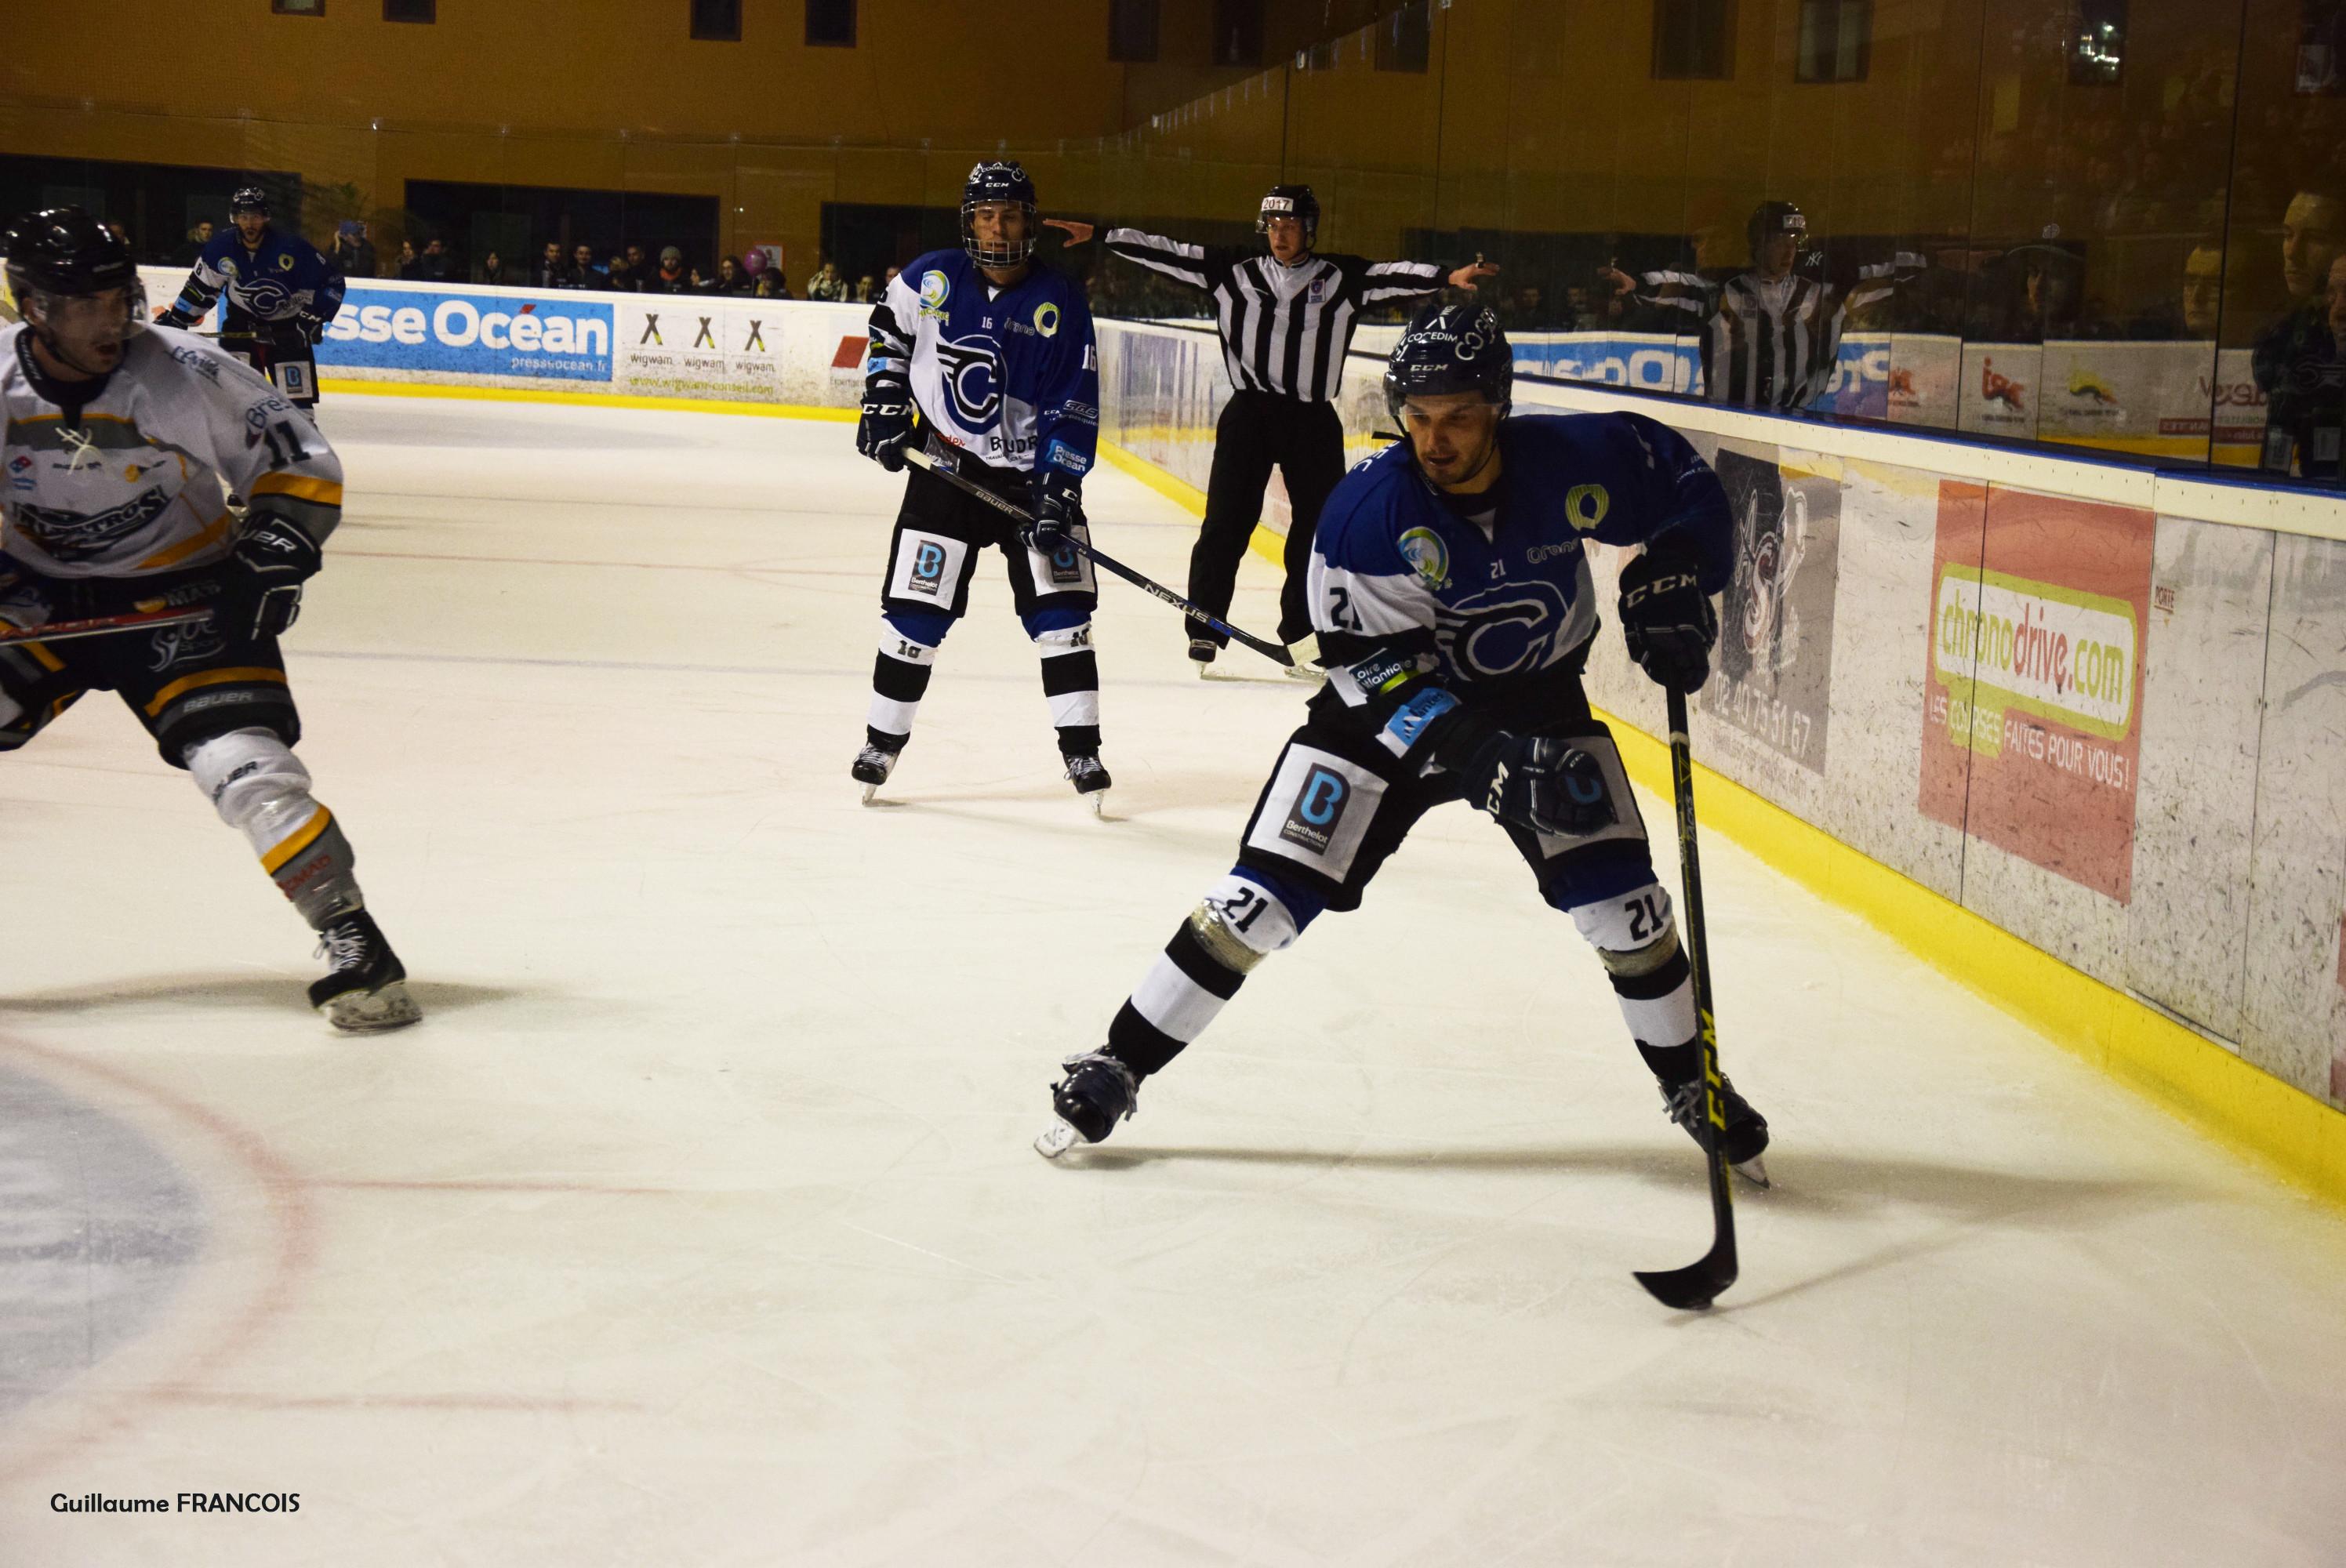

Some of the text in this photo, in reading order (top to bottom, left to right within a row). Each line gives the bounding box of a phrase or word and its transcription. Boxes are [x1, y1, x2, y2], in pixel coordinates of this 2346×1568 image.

[1262, 199, 1290, 210] 2017
[322, 299, 608, 356] sse Océan
[982, 316, 993, 329] 16
[630, 353, 673, 367] wigwam
[684, 355, 724, 371] wigwam
[735, 360, 775, 374] wigwam
[1082, 343, 1097, 372] 16
[629, 376, 774, 395] www.wigwam-conseil.com
[862, 403, 914, 416] CCM
[263, 420, 312, 469] 11
[1055, 445, 1088, 464] Presse
[1053, 453, 1086, 472] Ocean
[975, 490, 1015, 514] BAUER
[1490, 559, 1506, 579] 21
[1143, 583, 1208, 623] NEXUS
[1626, 574, 1698, 609] CCM
[1329, 586, 1363, 631] 21
[1942, 588, 2125, 705] chronodrive.com
[183, 690, 255, 713] BAUER
[1715, 670, 1730, 716] 02
[1734, 681, 1749, 725] 40
[1772, 699, 1787, 746] 51
[1792, 710, 1810, 760] 67
[1930, 695, 1948, 725] LES
[1950, 700, 2002, 746] COURSES
[2004, 720, 2044, 760] FAITES
[2048, 734, 2083, 775] POUR
[1487, 761, 1509, 815] CM
[1286, 819, 1328, 844] Berthelot
[1222, 887, 1269, 933] 21
[1625, 894, 1664, 942] 21
[1700, 1007, 1726, 1131] CCM
